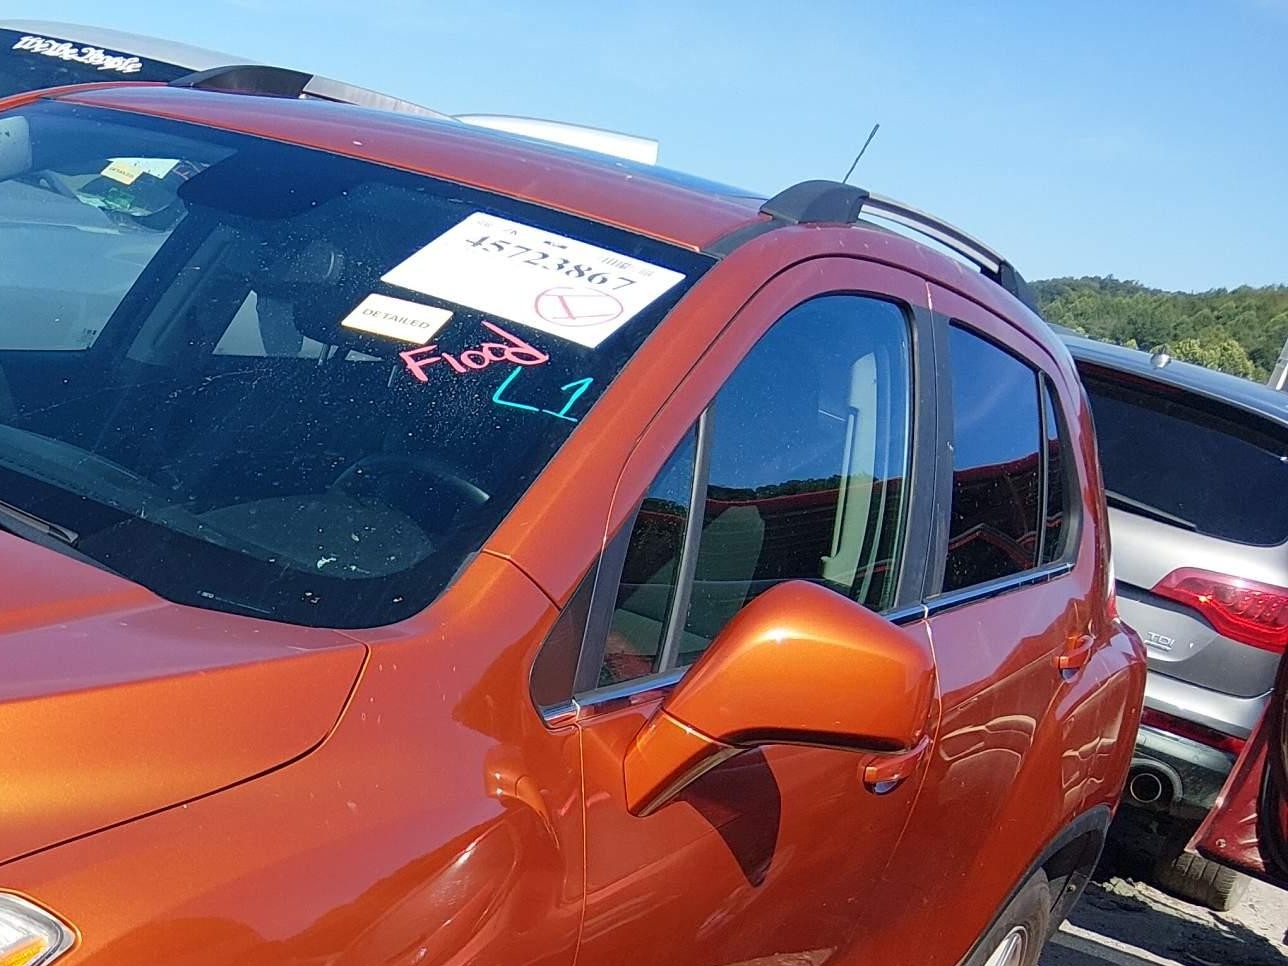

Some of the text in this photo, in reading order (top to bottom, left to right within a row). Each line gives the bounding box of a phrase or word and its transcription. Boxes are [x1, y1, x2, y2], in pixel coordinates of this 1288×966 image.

[465, 236, 638, 290] 45723867
[362, 308, 430, 329] DETAILED
[399, 320, 549, 382] Flood
[1147, 631, 1176, 647] TDI
